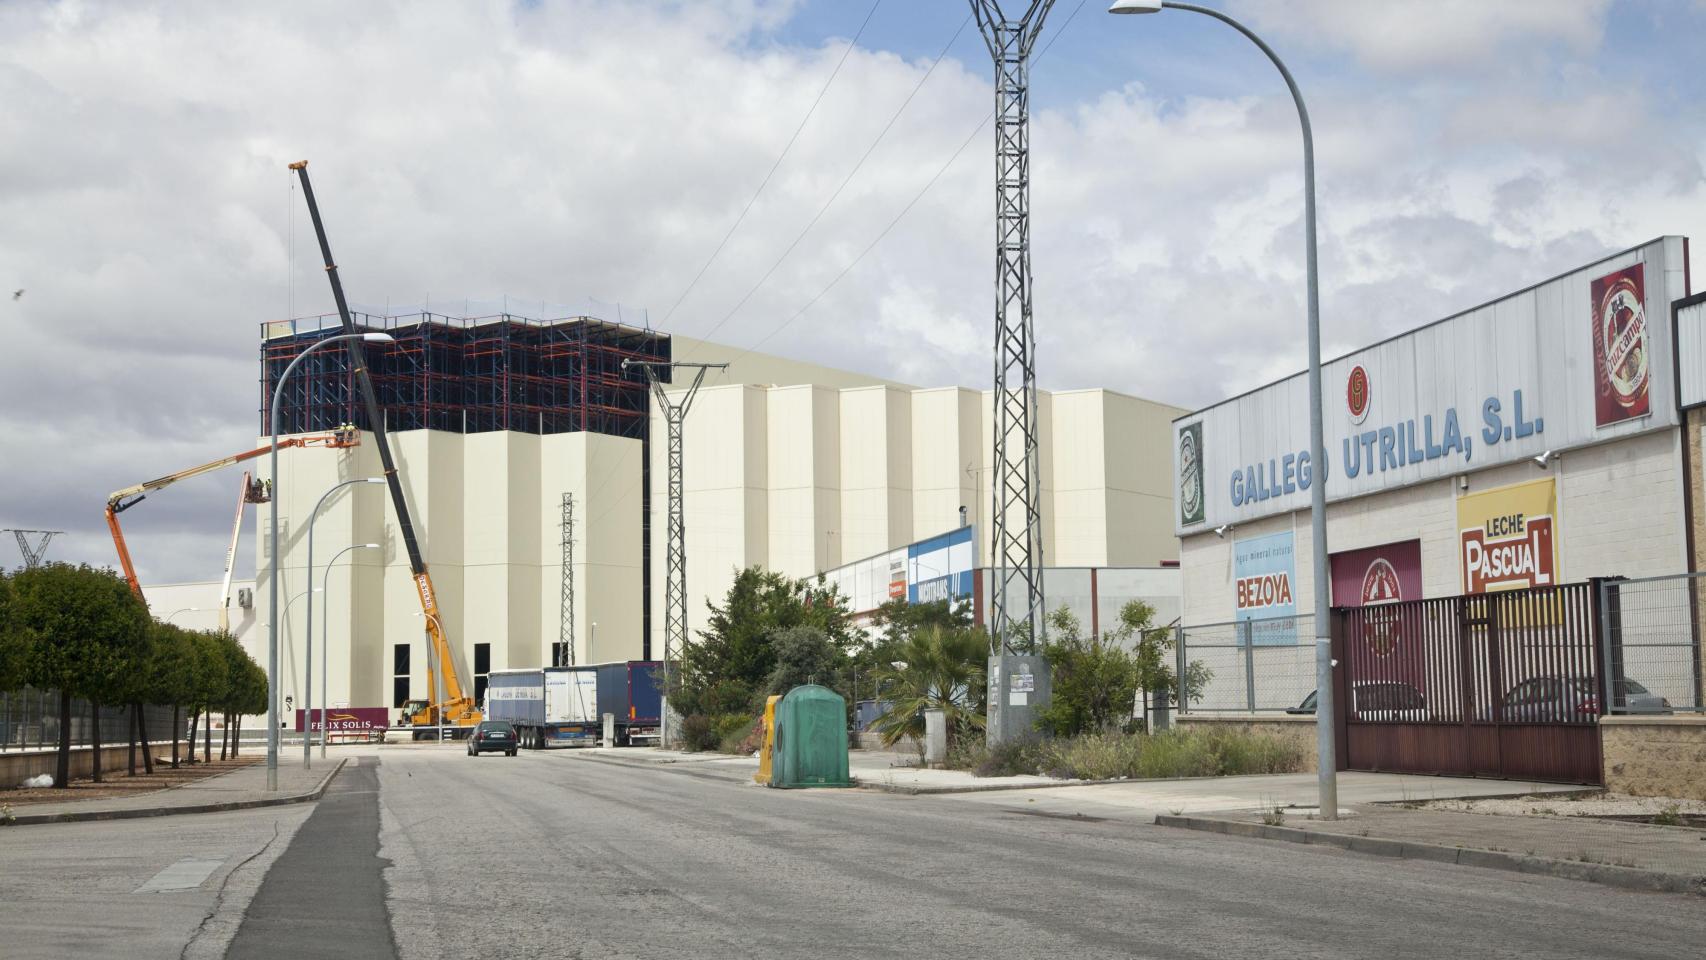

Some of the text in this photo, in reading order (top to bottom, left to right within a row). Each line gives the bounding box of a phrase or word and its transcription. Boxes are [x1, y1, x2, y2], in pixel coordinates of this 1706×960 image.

[1607, 310, 1644, 375] Cruzcampo
[1343, 408, 1471, 479] UTRILLA,
[1482, 389, 1544, 446] S.L.
[1486, 513, 1524, 537] LECHE
[1250, 548, 1271, 561] mineral
[1273, 544, 1293, 556] natural
[1466, 530, 1550, 592] PASCUAL
[1237, 574, 1292, 609] BEZOYA
[342, 721, 371, 729] SOLIS
